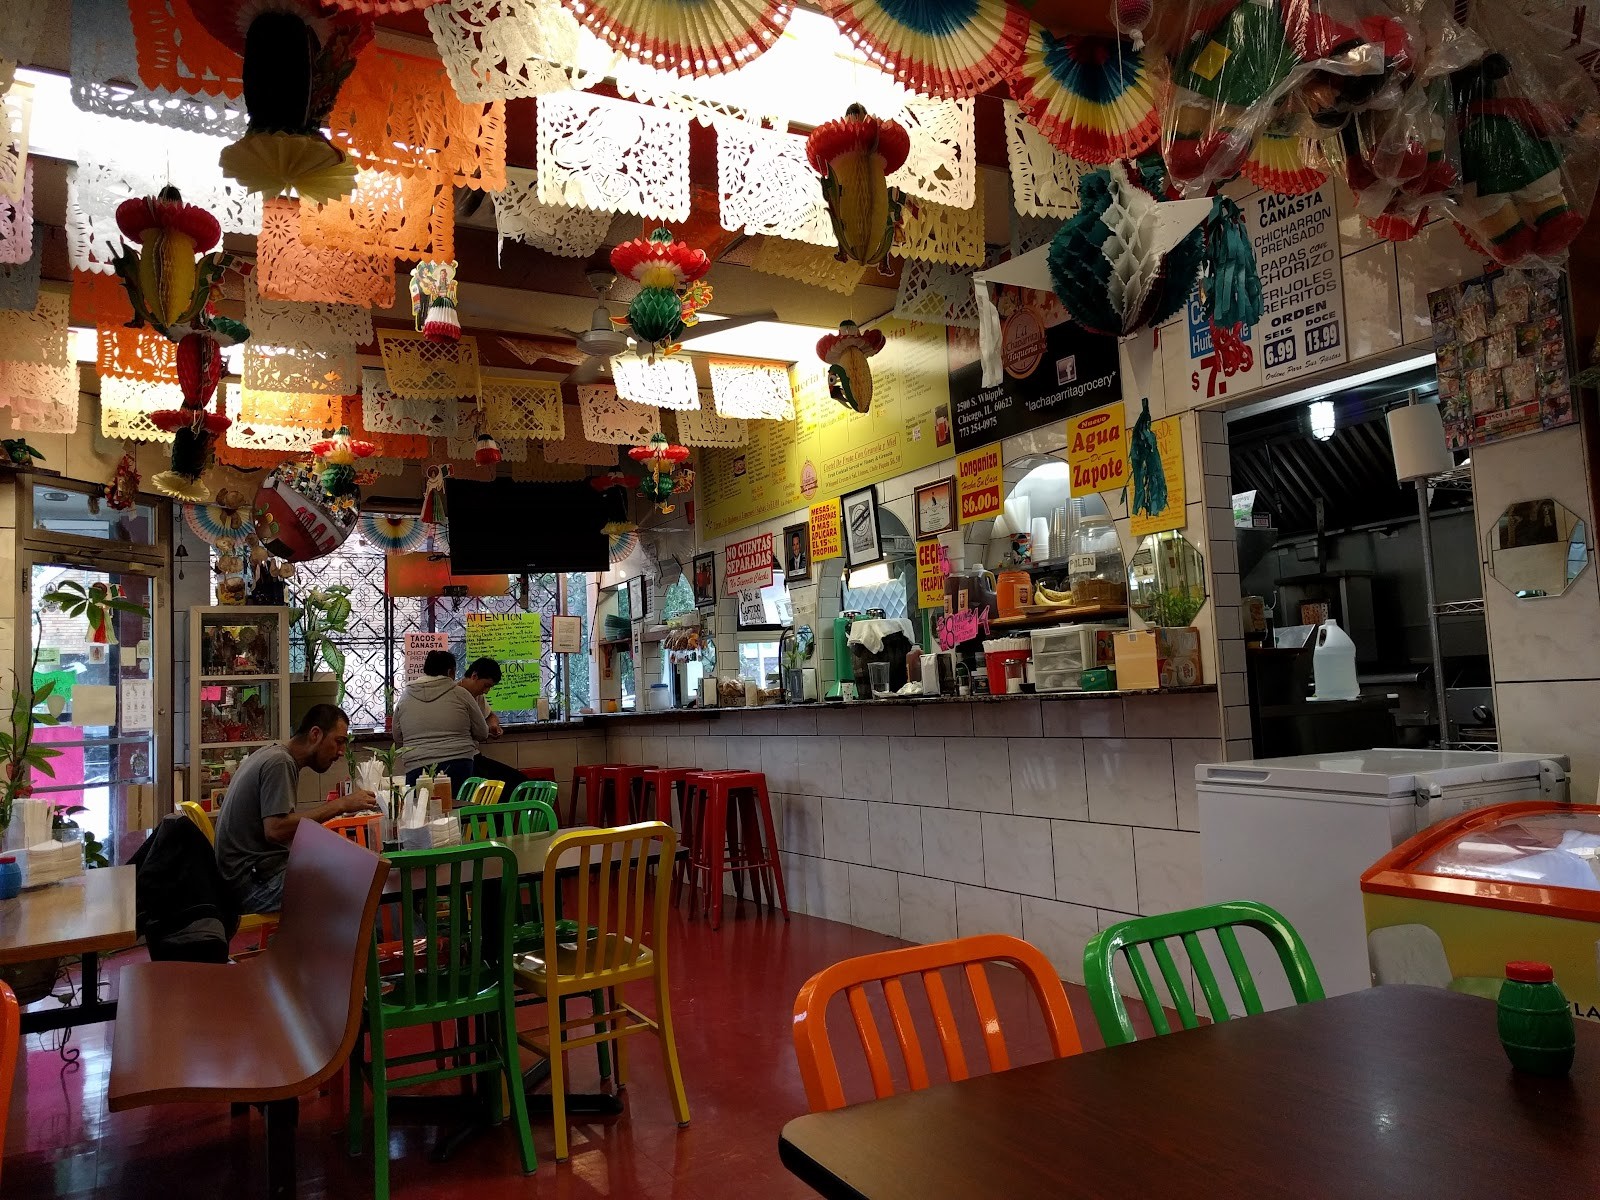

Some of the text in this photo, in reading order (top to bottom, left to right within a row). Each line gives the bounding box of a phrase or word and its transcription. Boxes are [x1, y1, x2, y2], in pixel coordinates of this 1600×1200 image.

[1260, 192, 1322, 227] CANASTA
[1255, 206, 1331, 247] CHICHARRON
[1262, 223, 1324, 257] PRENSADO
[1260, 250, 1334, 286] CHORIZO
[1261, 249, 1306, 275] PAPAS
[1263, 269, 1332, 300] FRIJOLES
[1264, 280, 1336, 314] REFRITOS
[1271, 300, 1326, 327] ORDEN
[1265, 311, 1335, 341] SEIS DOCE
[1266, 324, 1338, 365] 6.99 13.99
[978, 387, 1004, 404] Whipple
[958, 397, 1012, 425] Chicago, IL 60623
[1081, 416, 1106, 428] Nuevo
[959, 426, 970, 438] 773
[1072, 425, 1120, 453] Agua
[960, 452, 998, 478] Longaniza
[1090, 454, 1102, 462] De
[1074, 457, 1123, 488] Zapote
[811, 505, 829, 516] MESAS
[964, 493, 991, 513] $6.00
[815, 511, 836, 523] PERSONAS
[817, 521, 829, 529] MAS
[812, 528, 837, 541] APLICARA
[727, 536, 771, 561] NO CUENTAS
[813, 545, 838, 557] PROPINA
[919, 544, 939, 566] CECI
[727, 550, 771, 574] SEPARADAS
[932, 566, 939, 574] DE
[920, 576, 944, 592] YECAPIX
[467, 613, 522, 622] ATTENTION
